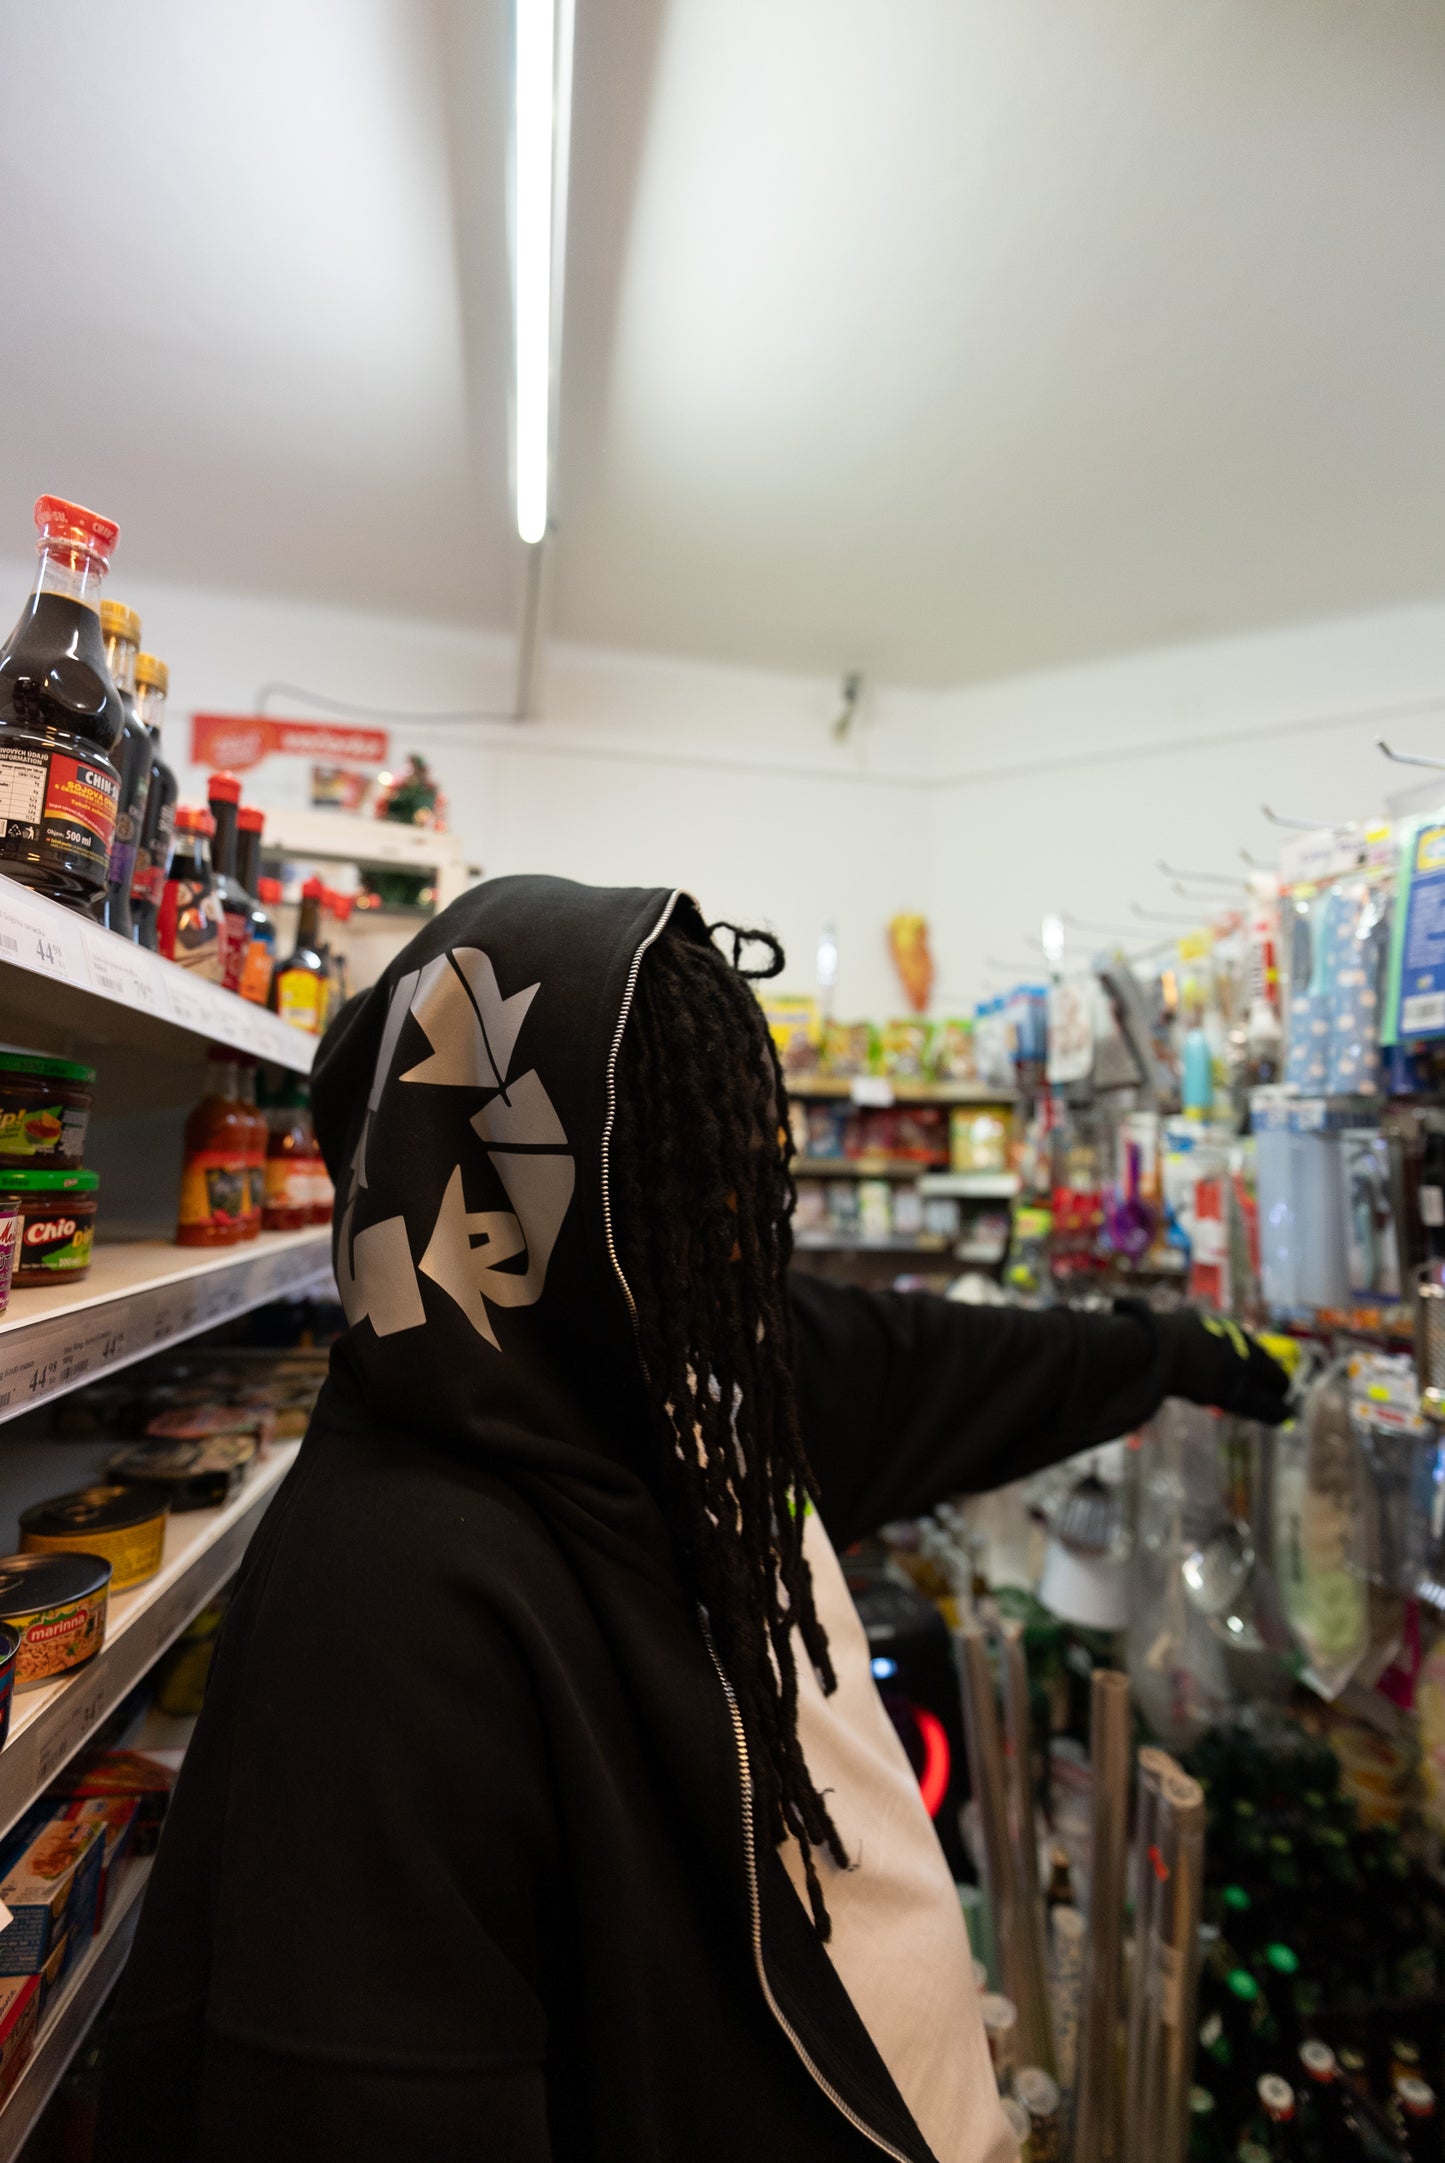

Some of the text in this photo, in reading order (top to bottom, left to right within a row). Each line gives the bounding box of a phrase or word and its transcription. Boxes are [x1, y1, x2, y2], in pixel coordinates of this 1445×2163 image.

[65, 830, 81, 843] 500
[81, 836, 92, 847] ml
[36, 938, 54, 964] 44
[26, 1218, 77, 1244] Chio
[29, 1365, 48, 1392] 44
[30, 1613, 86, 1641] marinna
